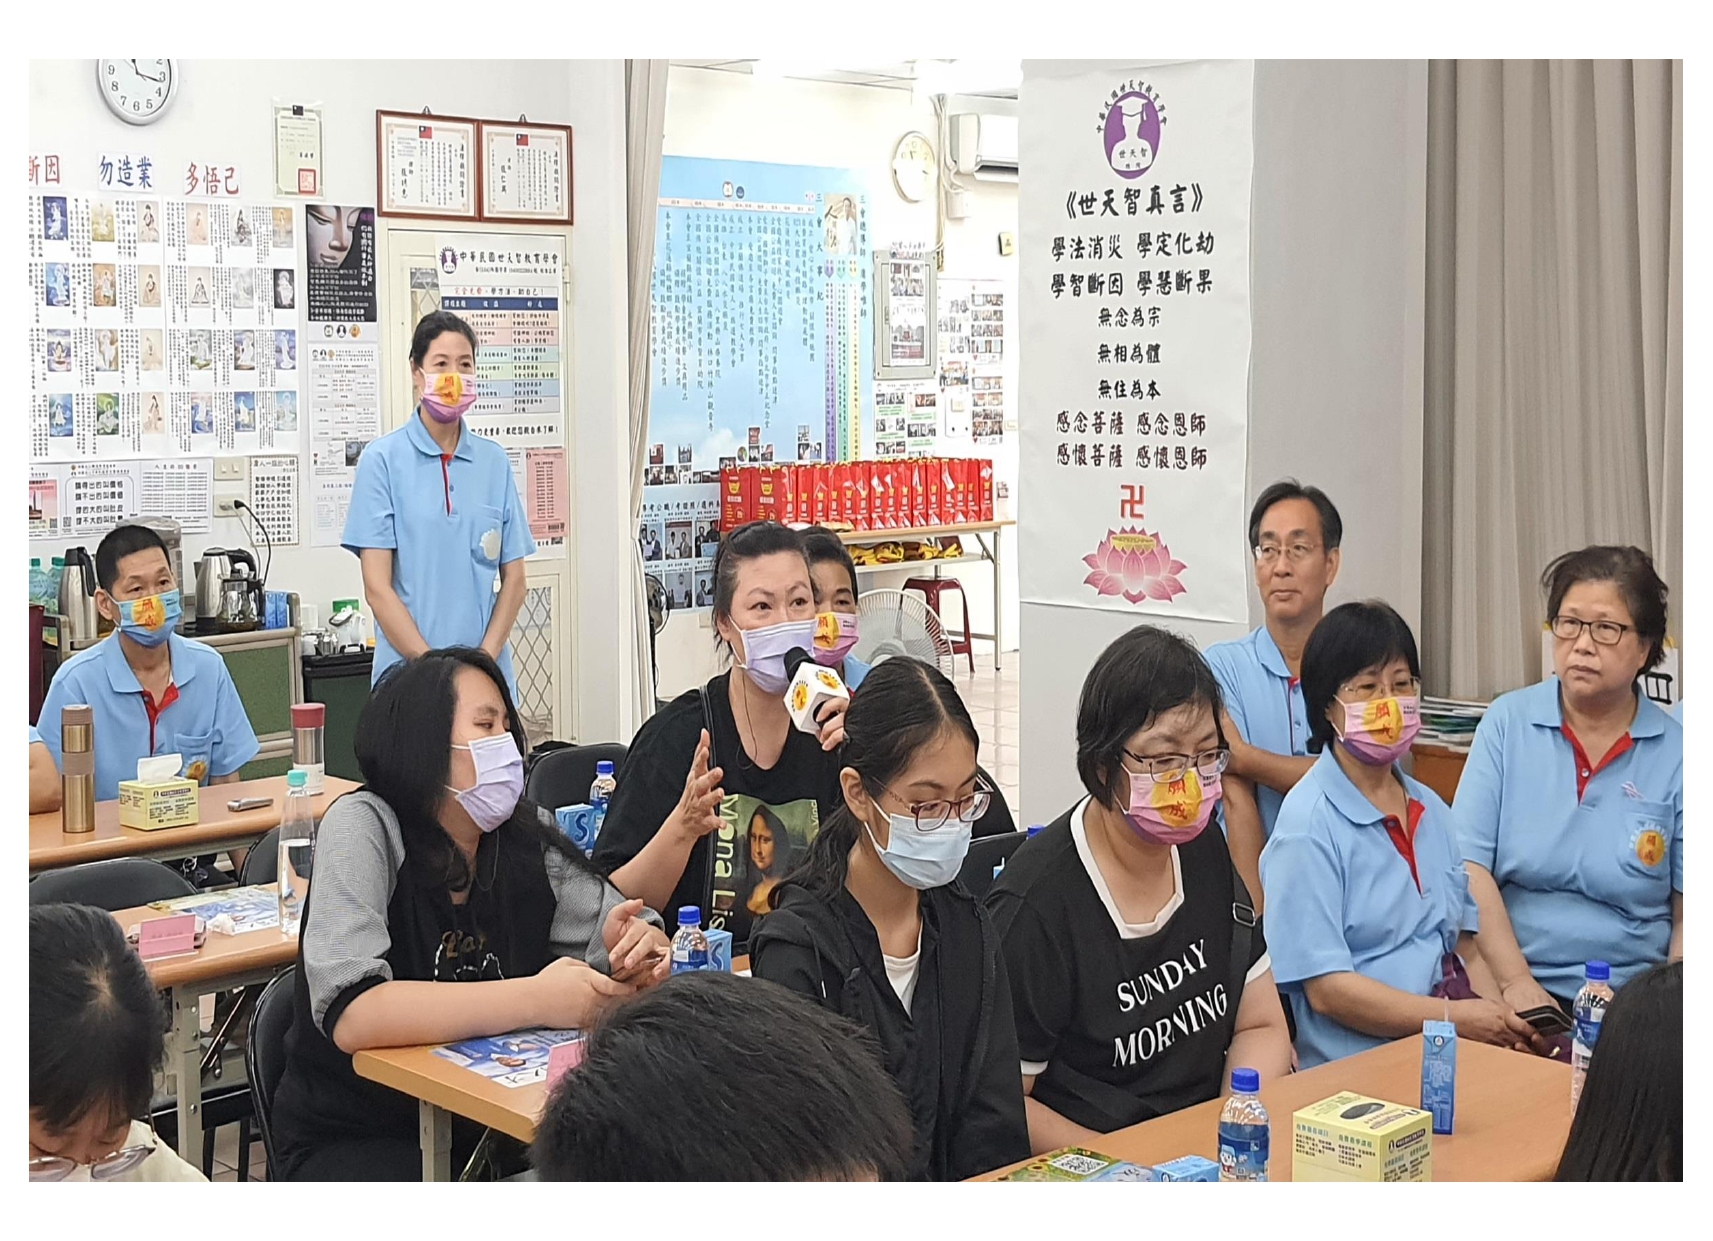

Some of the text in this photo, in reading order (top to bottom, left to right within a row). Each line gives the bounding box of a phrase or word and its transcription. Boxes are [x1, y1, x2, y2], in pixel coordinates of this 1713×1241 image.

[108, 64, 115, 76] 9
[159, 71, 166, 83] 3
[111, 80, 119, 92] 8
[155, 86, 162, 97] 4
[120, 95, 127, 106] 7
[133, 100, 140, 111] 6
[146, 98, 153, 109] 5
[99, 155, 153, 189] 勿造業
[184, 161, 239, 196] 多悟己
[1066, 183, 1203, 219] 《世天智真言》
[1051, 231, 1214, 262] 學法消災 學定化劫
[1051, 269, 1213, 299] 學智斷因 學慧斷果
[1098, 306, 1161, 328] 無念為宗
[1097, 343, 1162, 364] 無相為體
[1098, 379, 1162, 400] 無住為本
[1056, 410, 1206, 438] 感念菩薩 感念恩師
[1056, 443, 1207, 471] 感懷菩薩 感懷恩師
[715, 794, 739, 878] Mona
[1117, 938, 1207, 1012] SUNDAY
[1112, 983, 1228, 1067] MORNING
